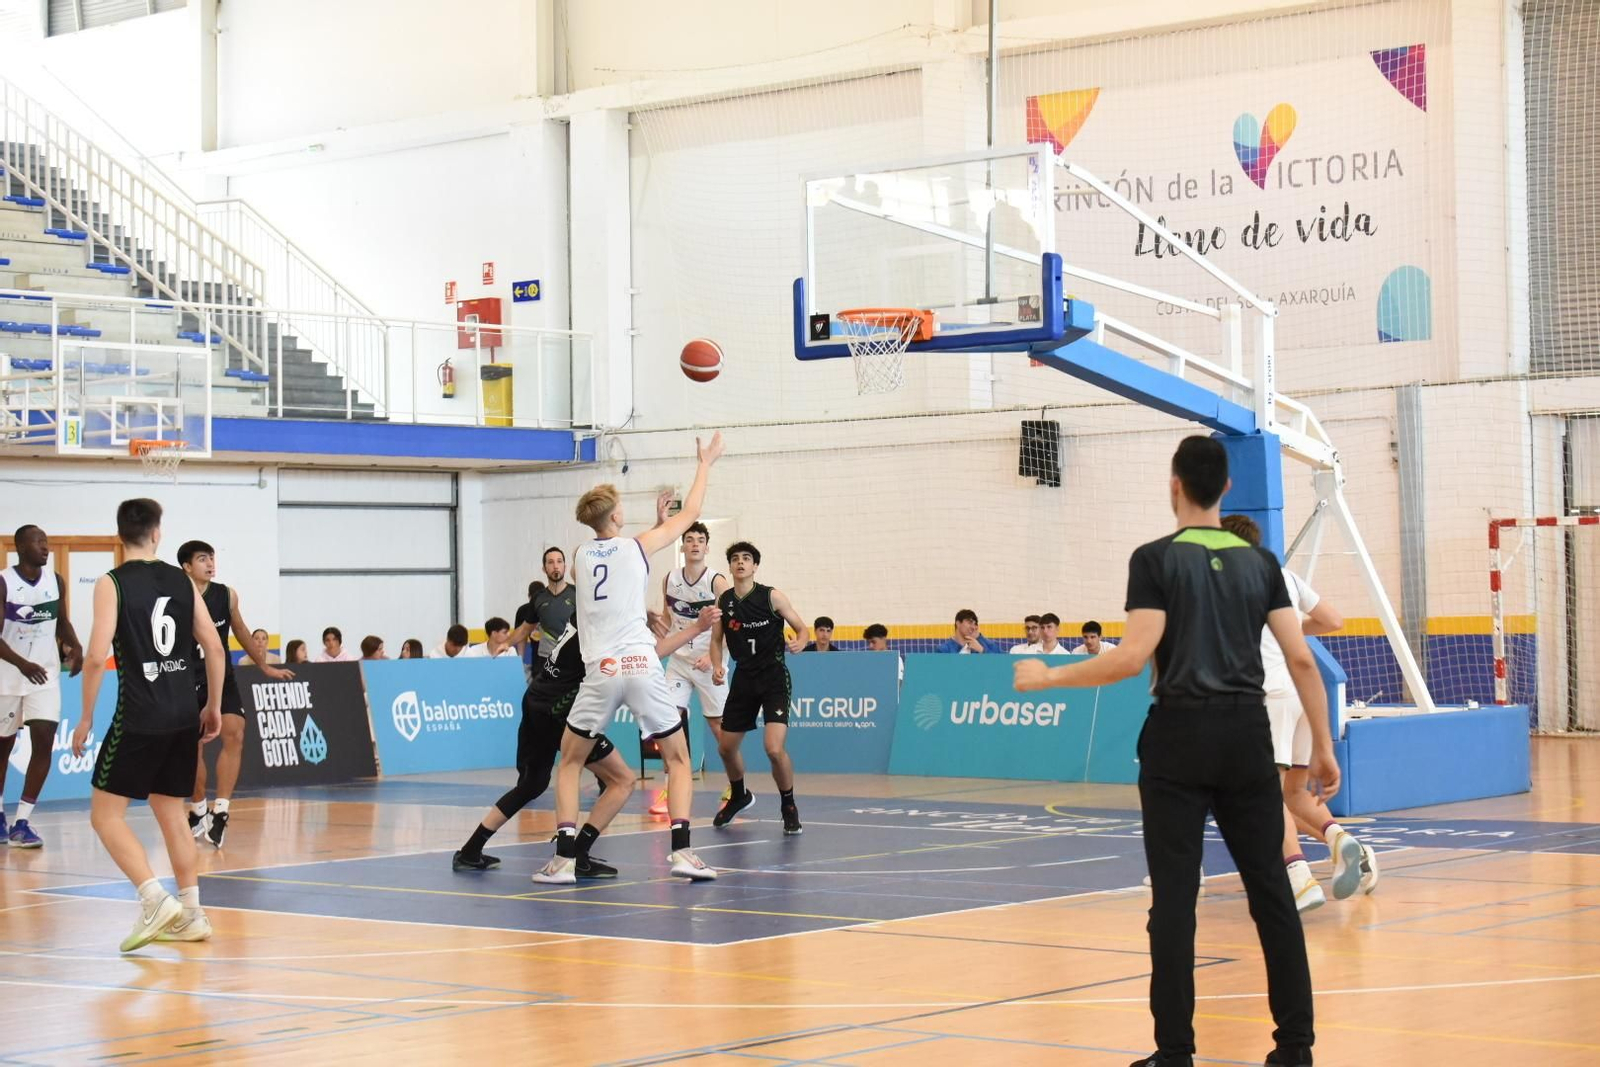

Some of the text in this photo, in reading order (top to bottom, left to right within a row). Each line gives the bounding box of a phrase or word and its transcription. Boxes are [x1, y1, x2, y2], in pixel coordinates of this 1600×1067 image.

[1167, 172, 1198, 201] de
[1211, 168, 1233, 197] la
[1240, 210, 1284, 251] de
[1295, 201, 1379, 243] vida
[1279, 282, 1357, 306] AXARQUÍA
[67, 424, 76, 441] 3
[593, 564, 608, 601] 2
[150, 596, 176, 657] 6
[620, 655, 648, 664] COSTA
[747, 638, 757, 655] 7
[251, 681, 313, 712] DEFIENDE
[818, 697, 877, 719] GRUP
[950, 693, 1066, 726] urbaser
[256, 710, 297, 739] CADA
[425, 721, 462, 733] ESPAÑA
[261, 738, 299, 768] GOTA
